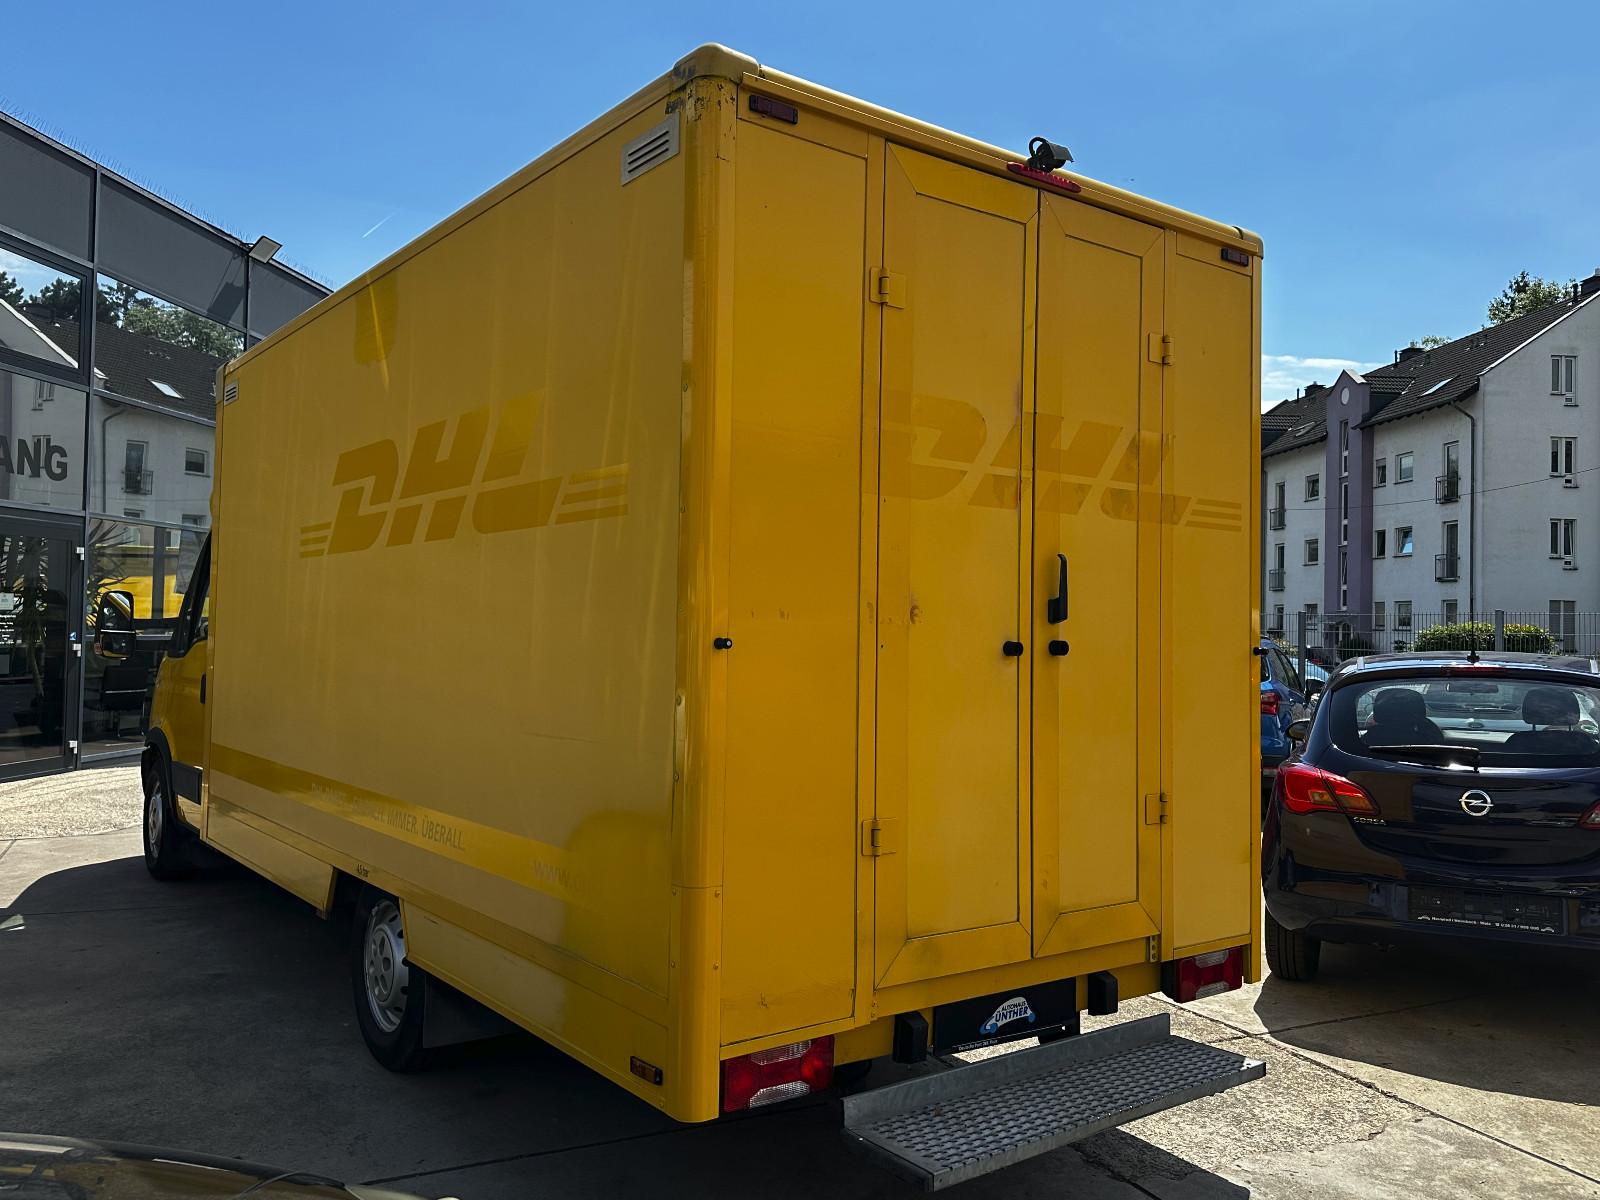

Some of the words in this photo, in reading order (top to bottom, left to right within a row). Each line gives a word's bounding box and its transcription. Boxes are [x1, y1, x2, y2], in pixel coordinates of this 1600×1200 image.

[327, 389, 564, 556] DHL
[865, 391, 1193, 526] DHL
[1353, 816, 1388, 827] CORSA
